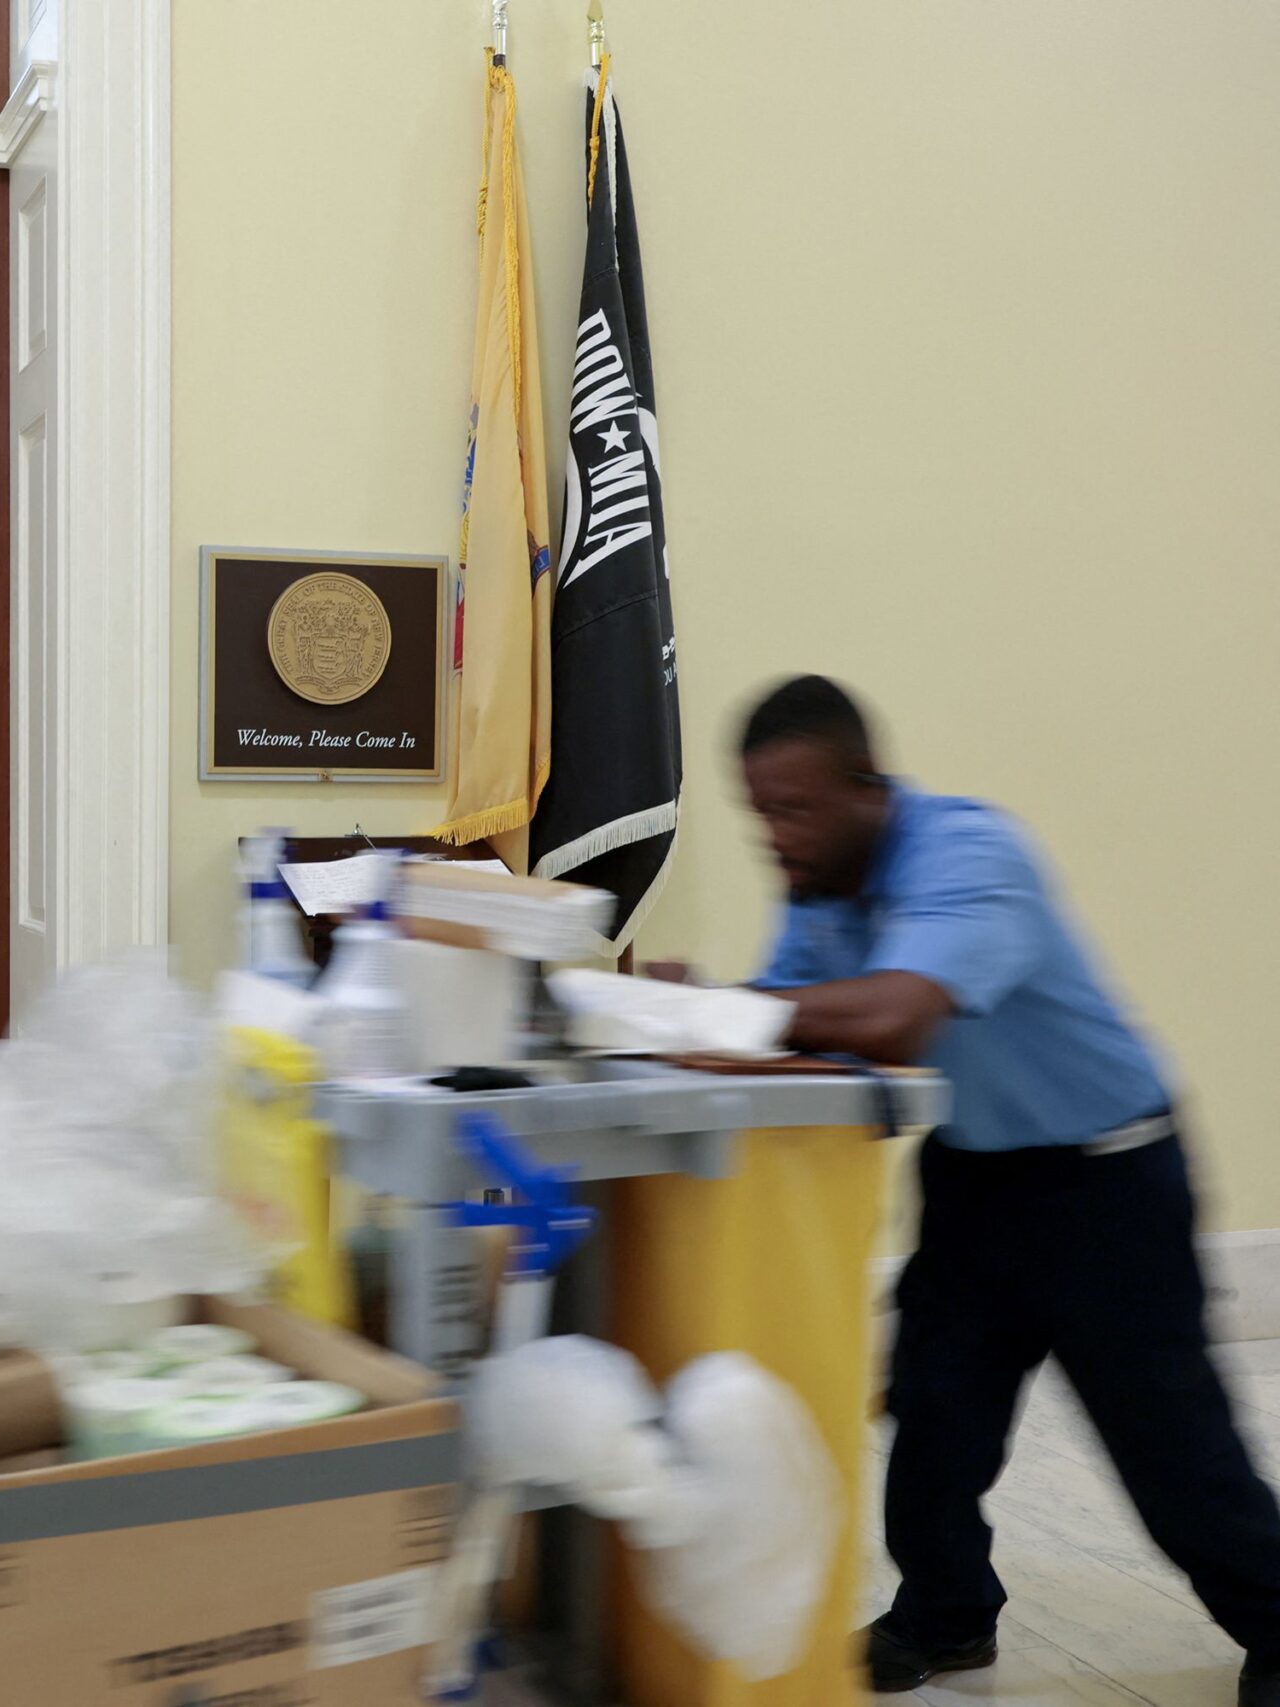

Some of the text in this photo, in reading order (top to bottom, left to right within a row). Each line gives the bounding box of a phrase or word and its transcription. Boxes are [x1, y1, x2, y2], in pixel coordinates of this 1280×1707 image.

[563, 449, 652, 589] MIA
[237, 729, 416, 748] Welcome, Please Come In
